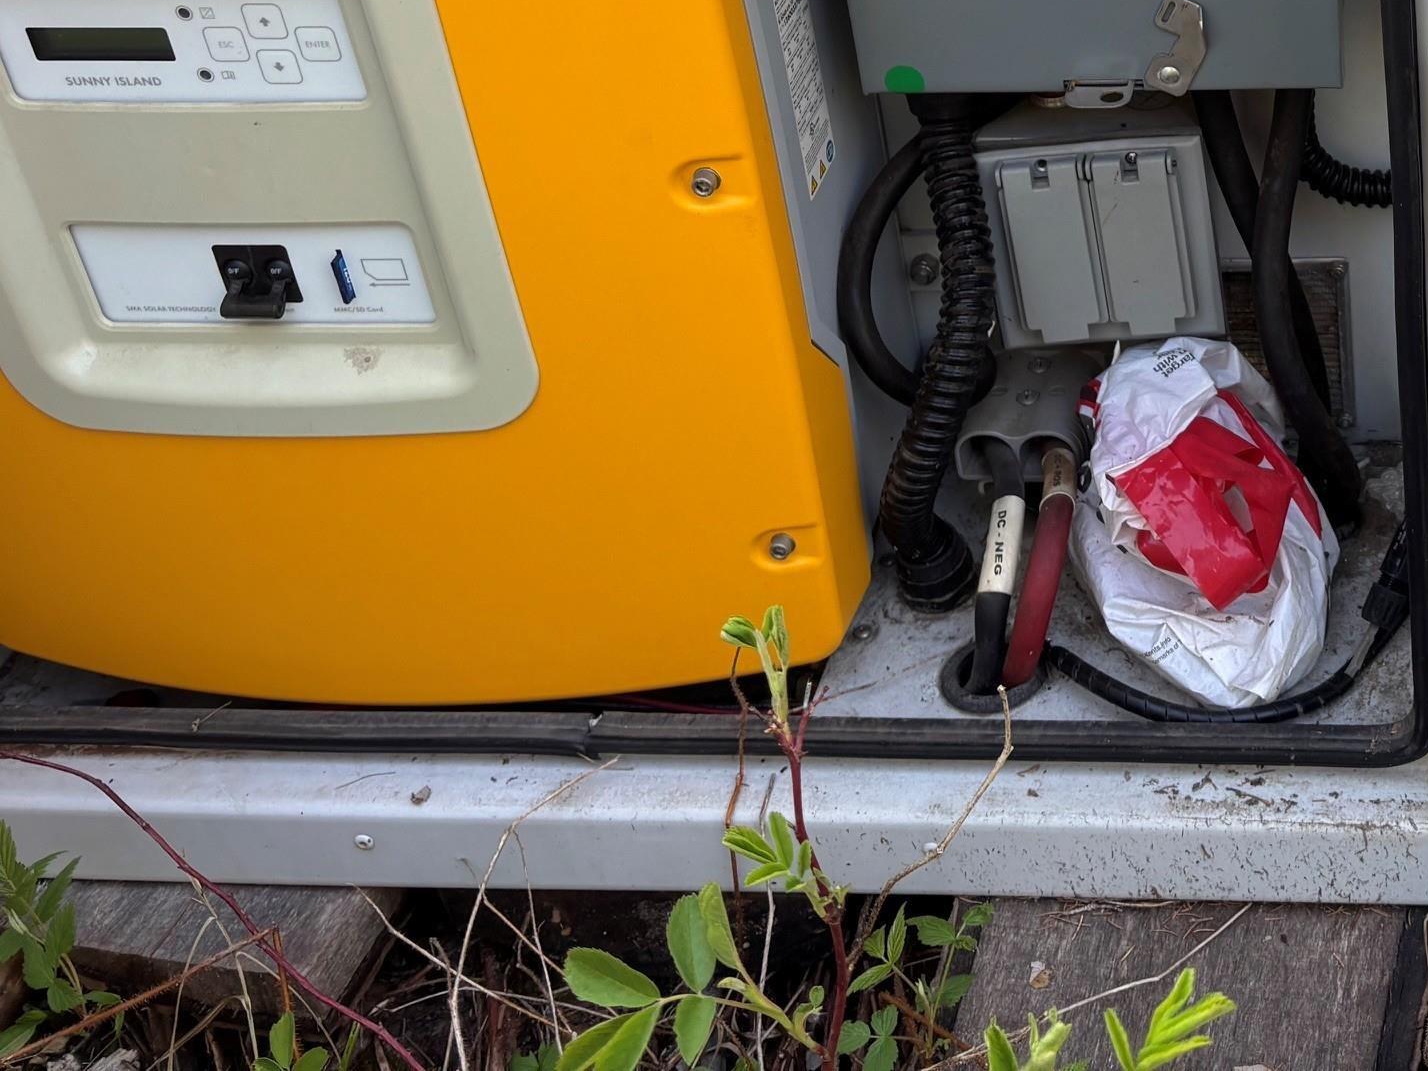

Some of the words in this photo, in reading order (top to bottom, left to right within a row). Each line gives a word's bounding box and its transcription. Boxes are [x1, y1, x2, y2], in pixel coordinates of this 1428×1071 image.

[217, 40, 234, 48] ESC
[304, 40, 330, 48] ENTER
[65, 77, 111, 87] SUNNY
[114, 77, 162, 87] ISLAND
[997, 510, 1007, 528] DC
[994, 541, 1004, 576] NEG
